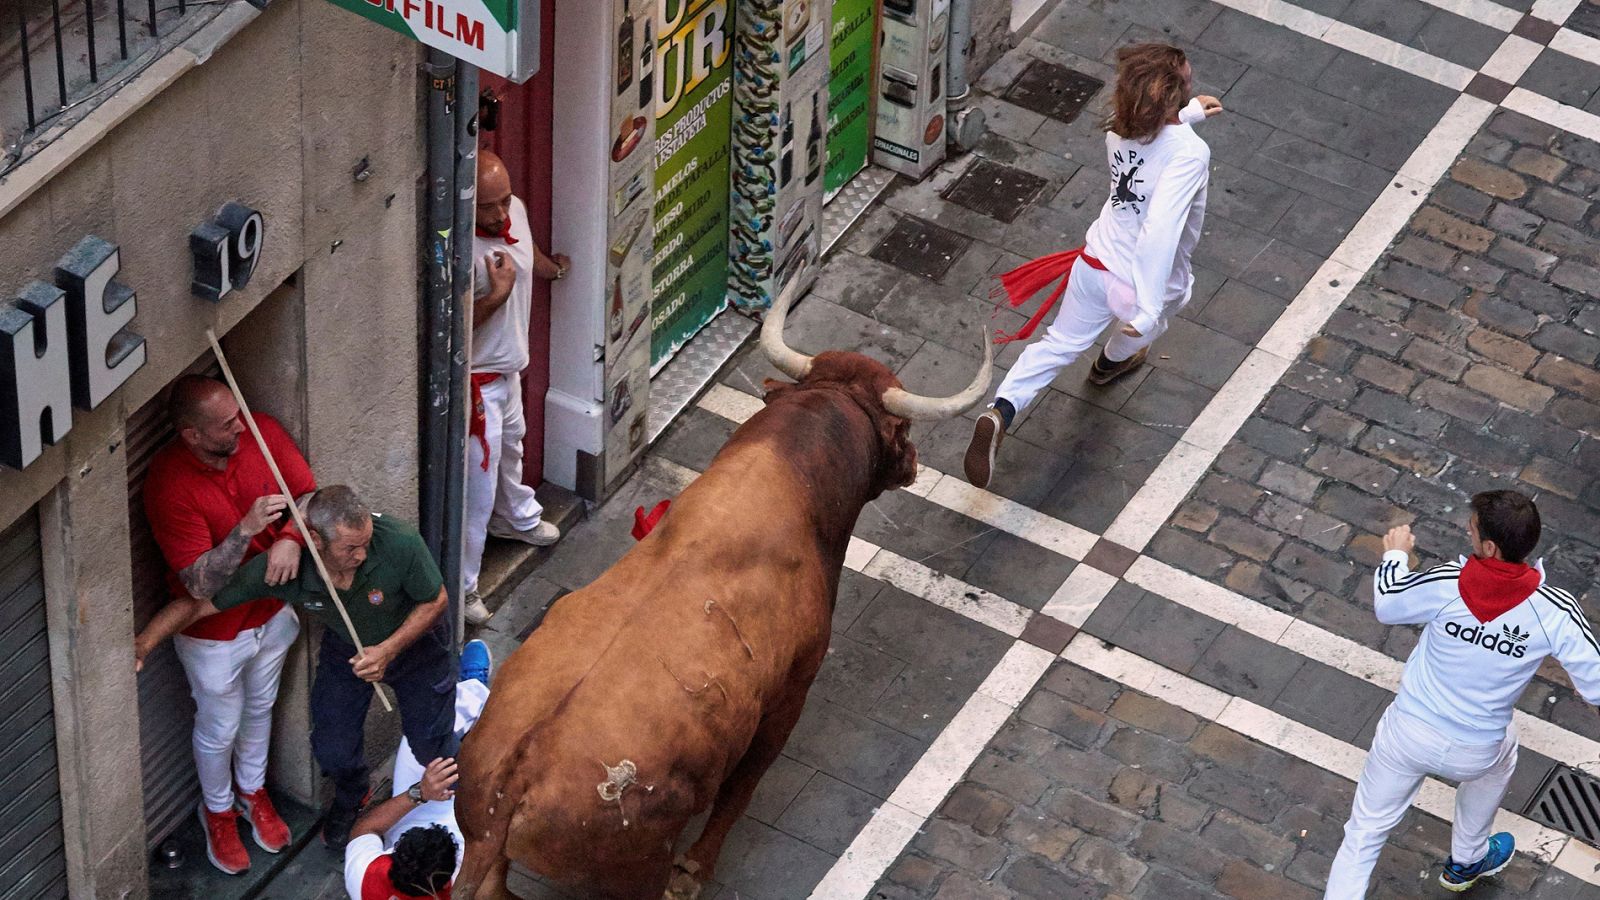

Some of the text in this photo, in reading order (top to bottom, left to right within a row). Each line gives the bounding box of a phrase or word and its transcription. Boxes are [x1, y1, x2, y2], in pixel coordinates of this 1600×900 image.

[365, 0, 485, 51] FILM
[673, 77, 730, 136] PRODUCTOS
[660, 114, 707, 167] ESTAFETA
[683, 144, 729, 189] TAFALLA
[653, 202, 684, 236] UESO
[203, 206, 264, 301] 19
[4, 238, 147, 470] HE
[1445, 621, 1528, 659] adidas
